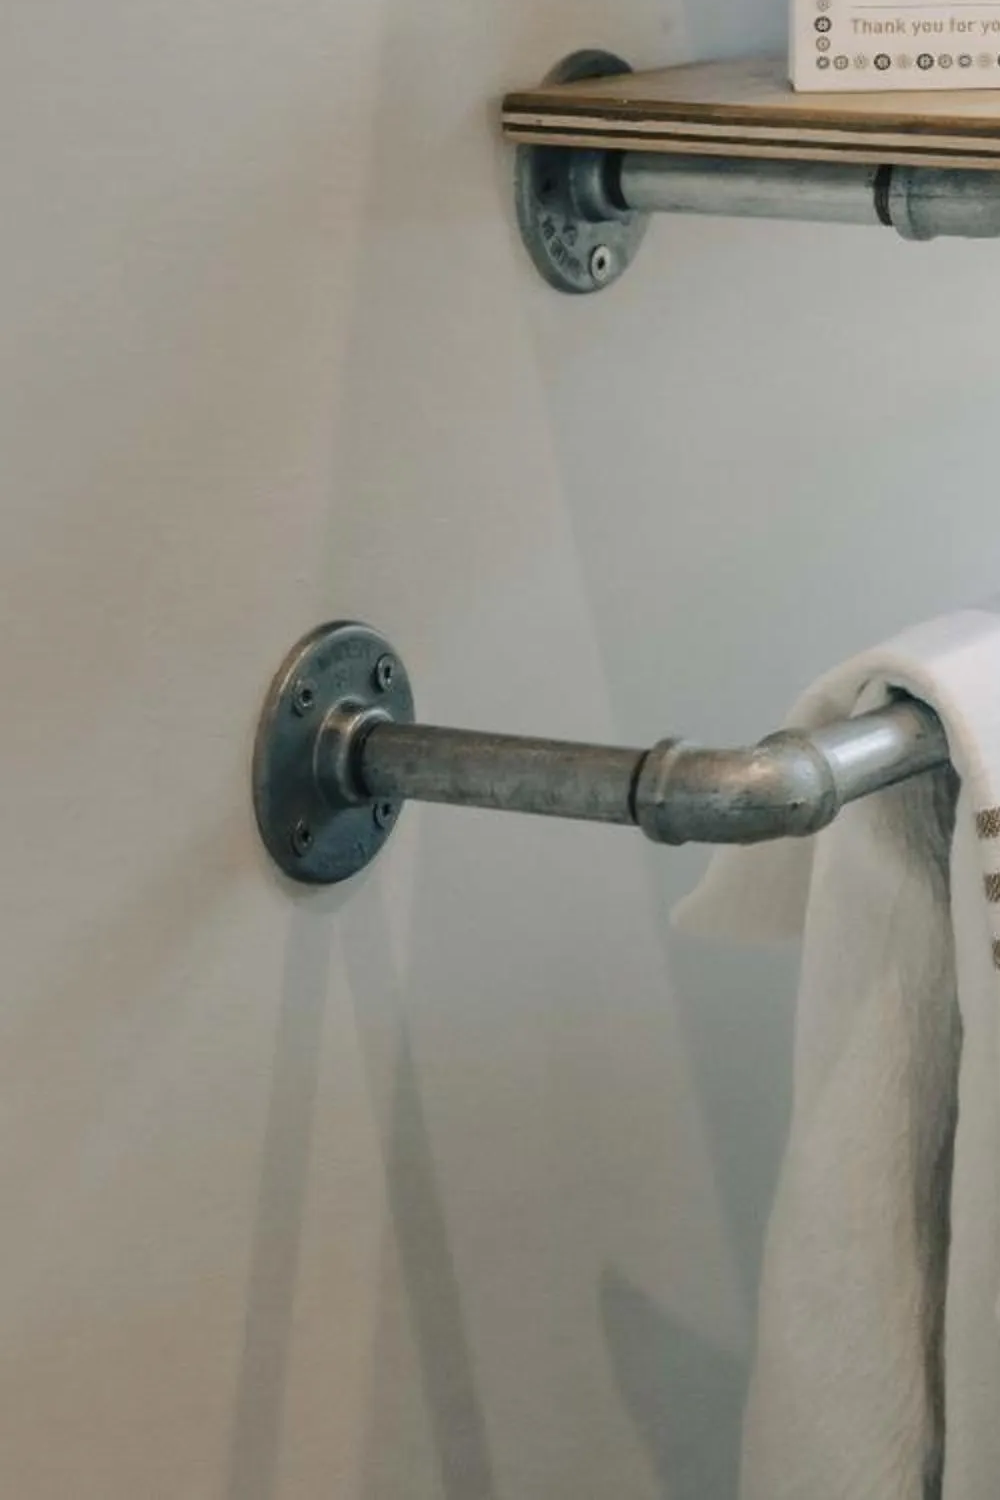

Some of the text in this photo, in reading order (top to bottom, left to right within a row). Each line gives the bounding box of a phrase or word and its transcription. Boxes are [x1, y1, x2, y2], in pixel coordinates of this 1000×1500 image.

[851, 17, 906, 34] Thank
[912, 20, 944, 37] you
[950, 16, 975, 34] for
